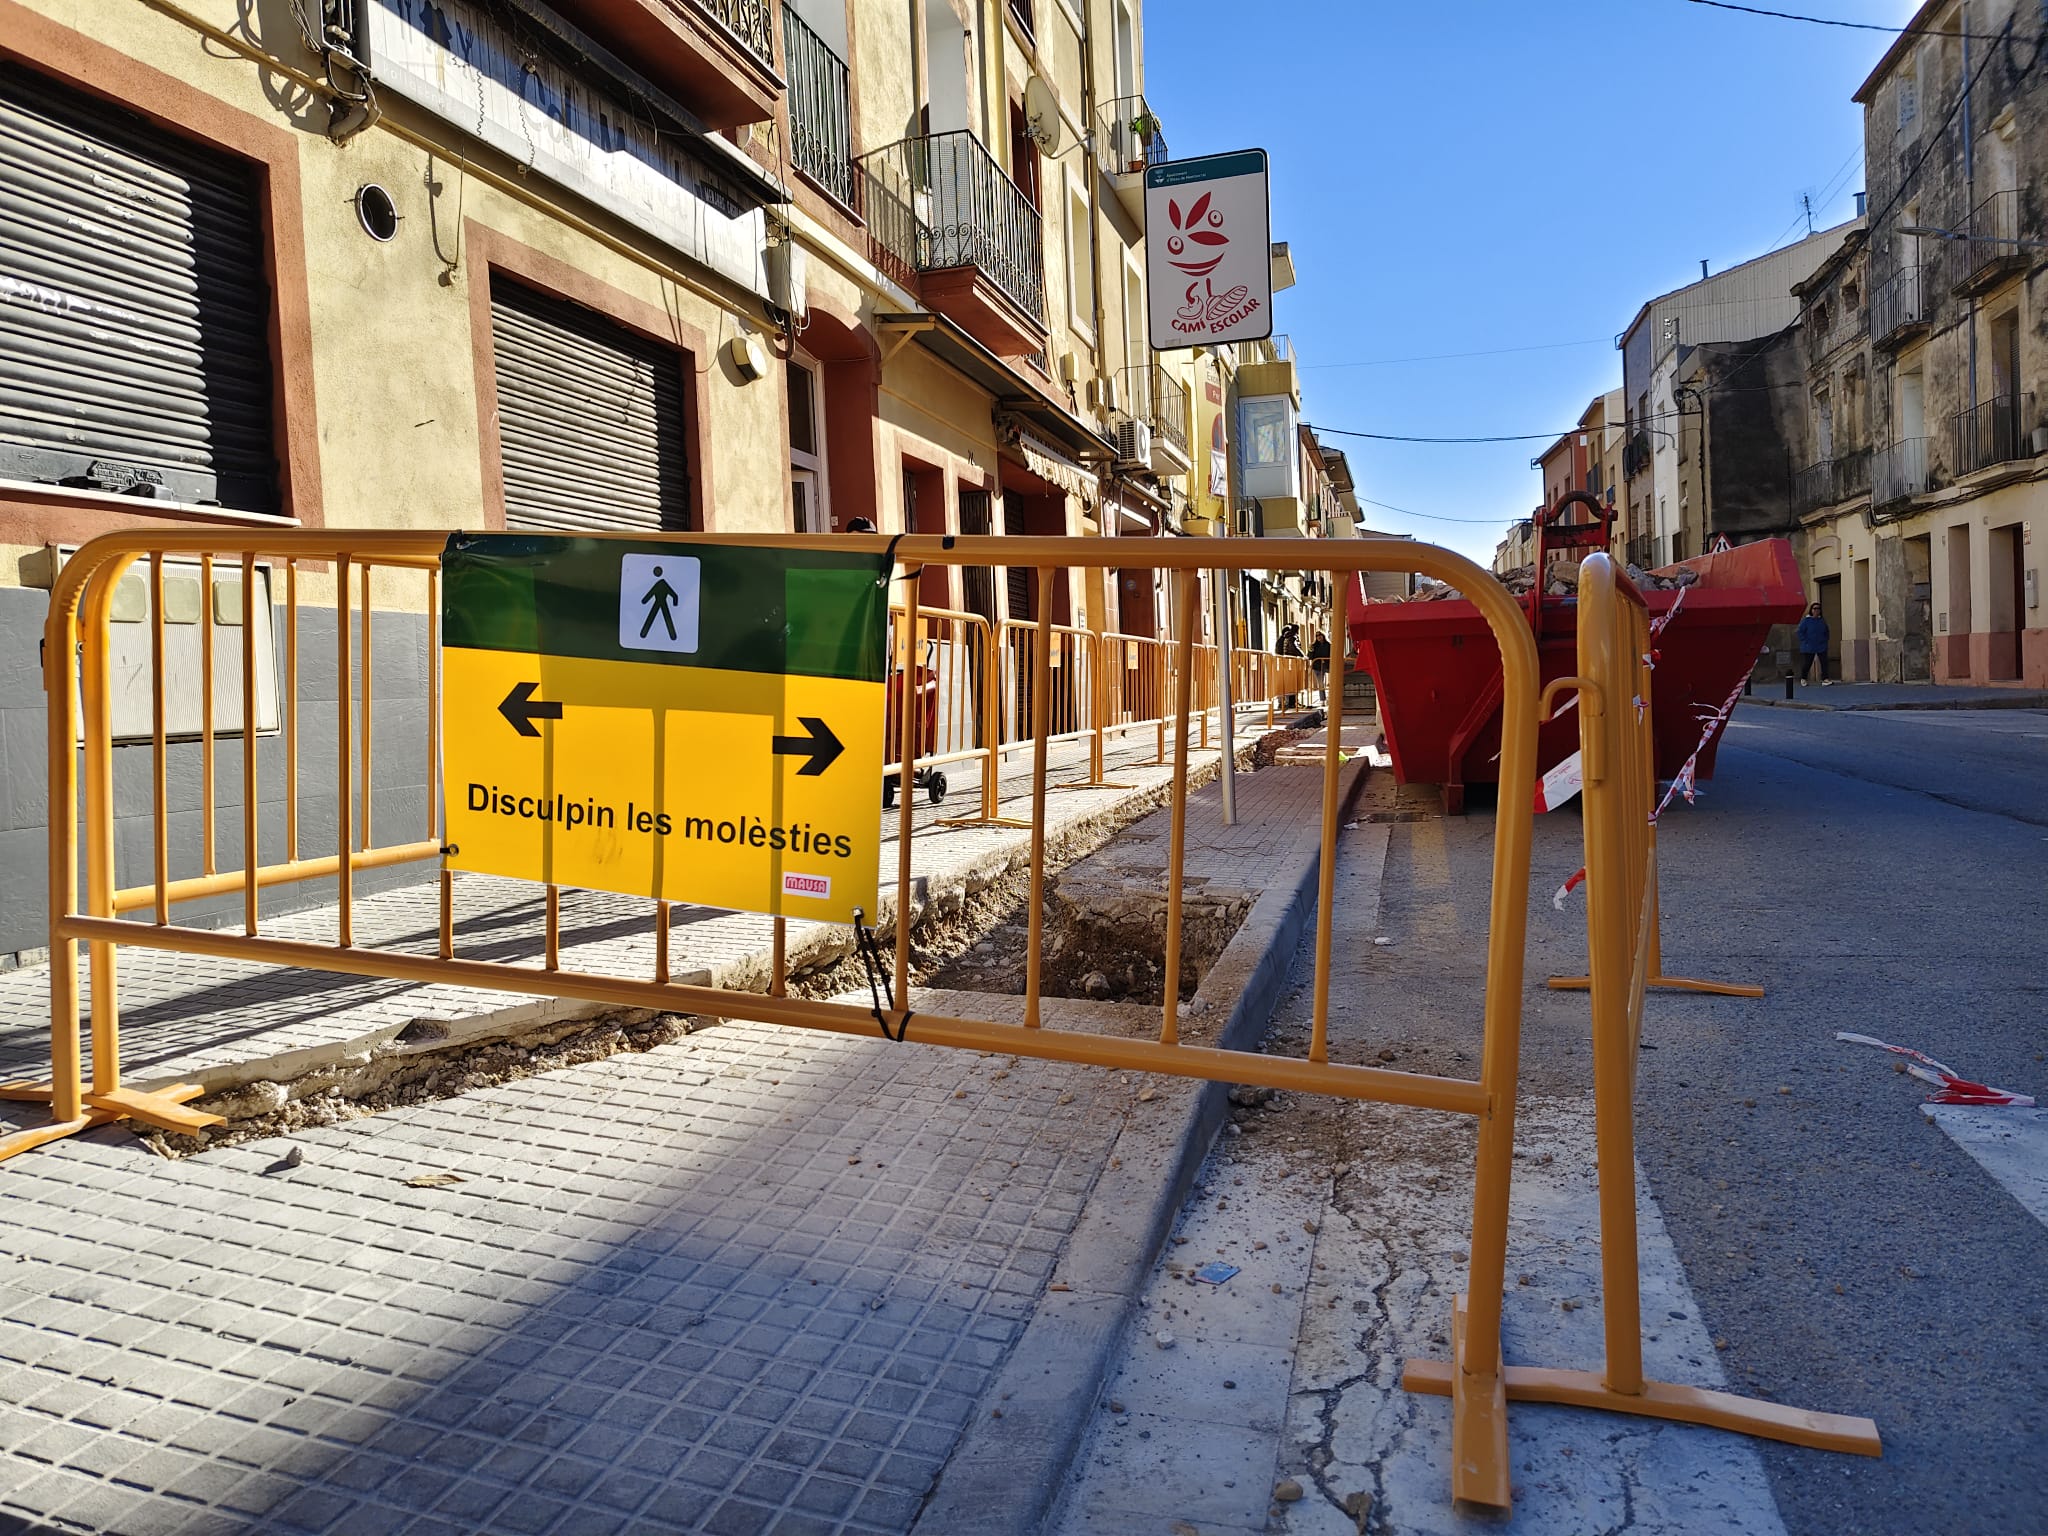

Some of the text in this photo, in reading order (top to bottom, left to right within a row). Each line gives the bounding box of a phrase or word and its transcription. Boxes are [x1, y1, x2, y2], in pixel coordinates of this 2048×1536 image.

[1171, 298, 1261, 334] CAMÍ ESCOLAR
[467, 782, 852, 858] Disculpin les molèsties
[786, 876, 827, 893] MAUSA
